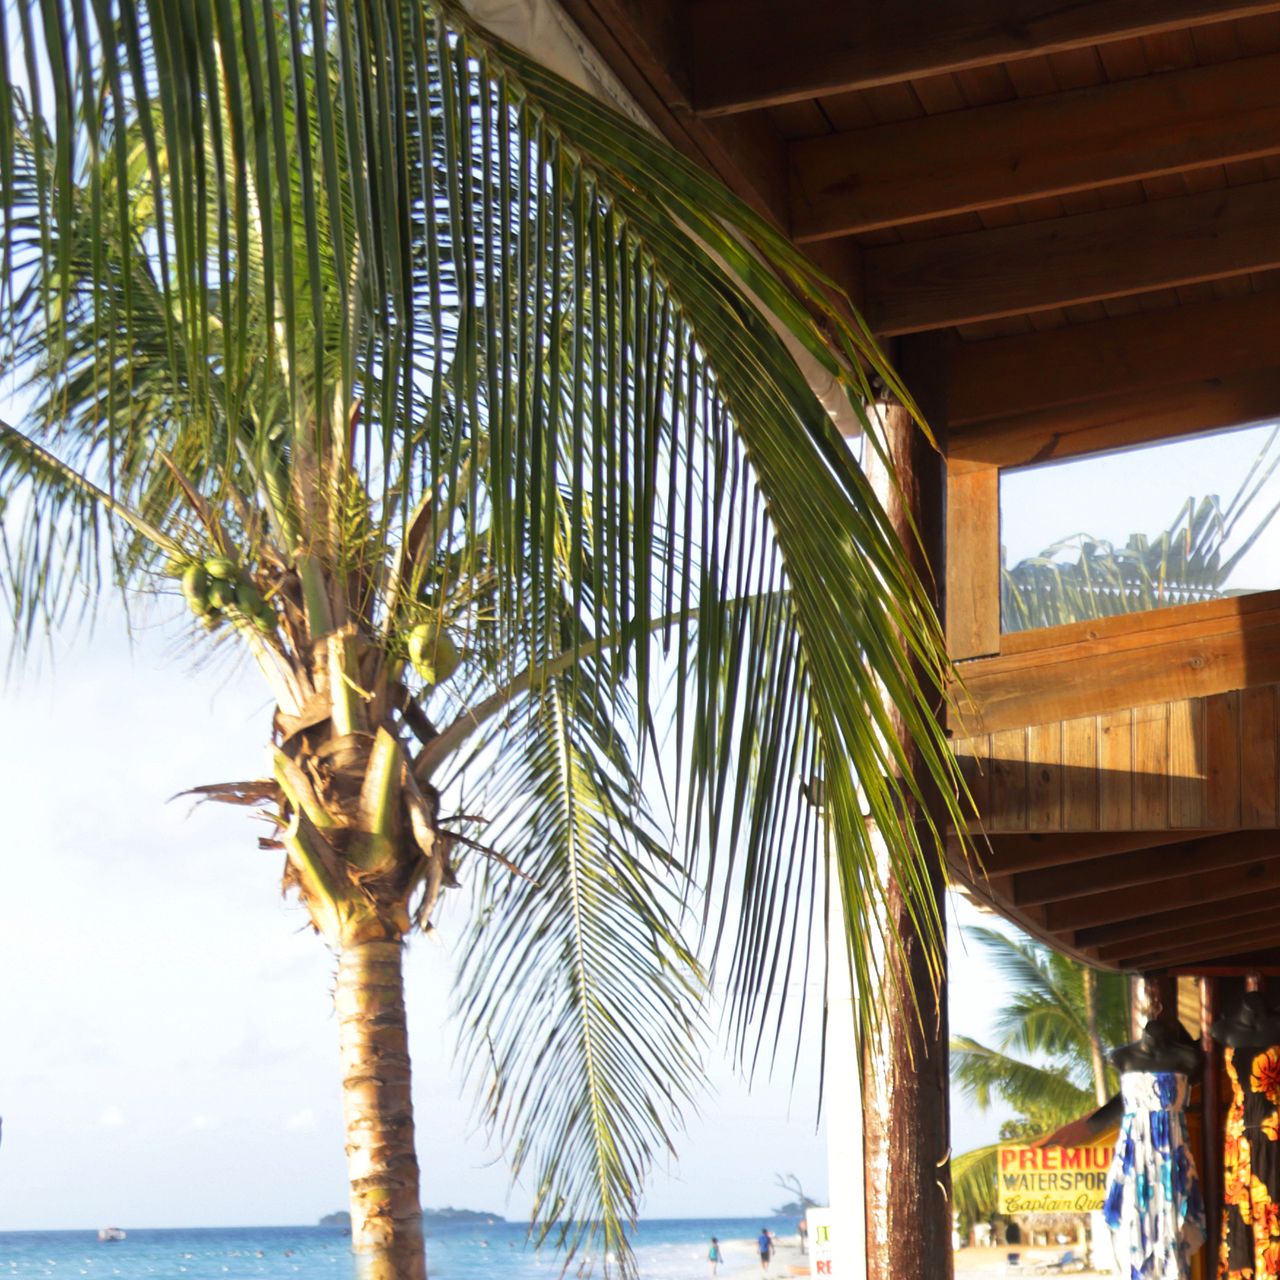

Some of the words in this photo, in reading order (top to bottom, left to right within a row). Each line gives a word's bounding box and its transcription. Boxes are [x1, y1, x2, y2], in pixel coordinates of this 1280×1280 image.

[1001, 1147, 1115, 1171] PREMIU
[1004, 1172, 1106, 1191] WATERSPOR
[1075, 1194, 1105, 1211] Qua
